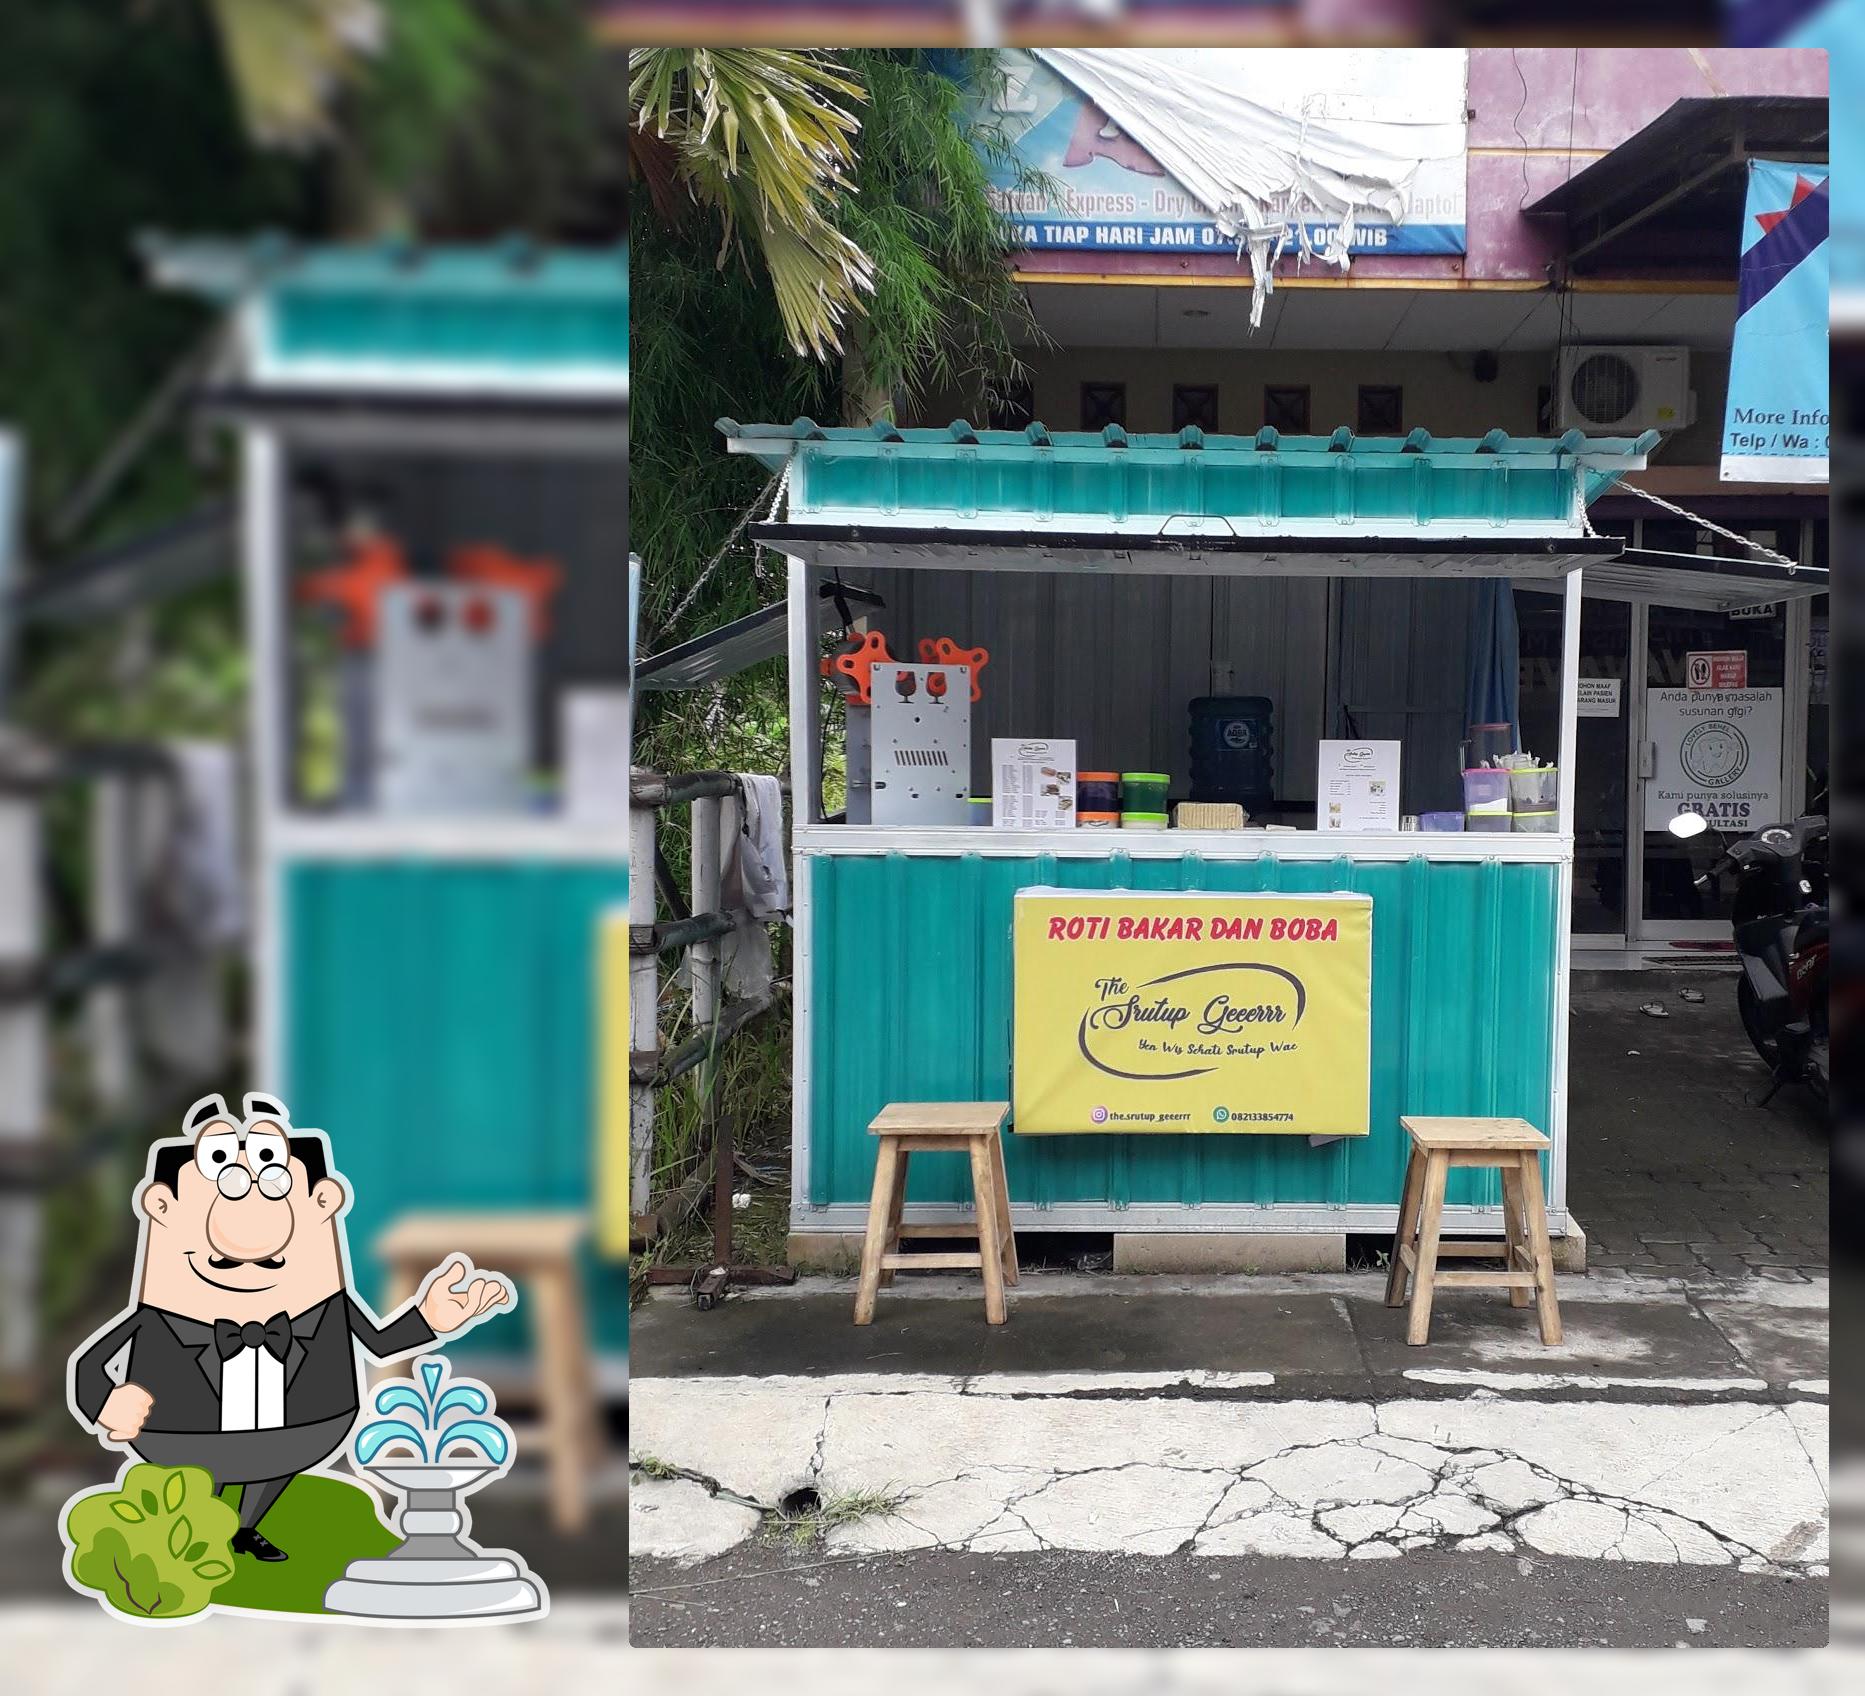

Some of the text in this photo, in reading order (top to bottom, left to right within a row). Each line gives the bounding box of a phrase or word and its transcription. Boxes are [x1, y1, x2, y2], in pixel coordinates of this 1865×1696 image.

[1066, 189, 1135, 217] Express
[1155, 190, 1184, 219] Dry
[1044, 225, 1090, 243] TIAP
[1096, 226, 1143, 244] HARI
[1150, 226, 1194, 244] JAM
[1733, 408, 1785, 424] More
[1730, 432, 1766, 450] Telp
[1783, 434, 1808, 448] Wa
[1660, 691, 1773, 703] Anda punya masalah
[1679, 706, 1753, 718] susunan gigi?
[1685, 726, 1706, 746] LOVELY
[1707, 766, 1741, 786] GALLERY
[1658, 790, 1769, 801] Kami punya solusinya
[1677, 802, 1751, 818] GRATIS
[1048, 916, 1339, 942] ROTI BAKAR DAN BOBA
[1095, 977, 1129, 1001] The
[1090, 995, 1287, 1035] Srutup Geeerrr
[1226, 1043, 1265, 1059] Srutup
[1231, 1112, 1294, 1122] 082133854774
